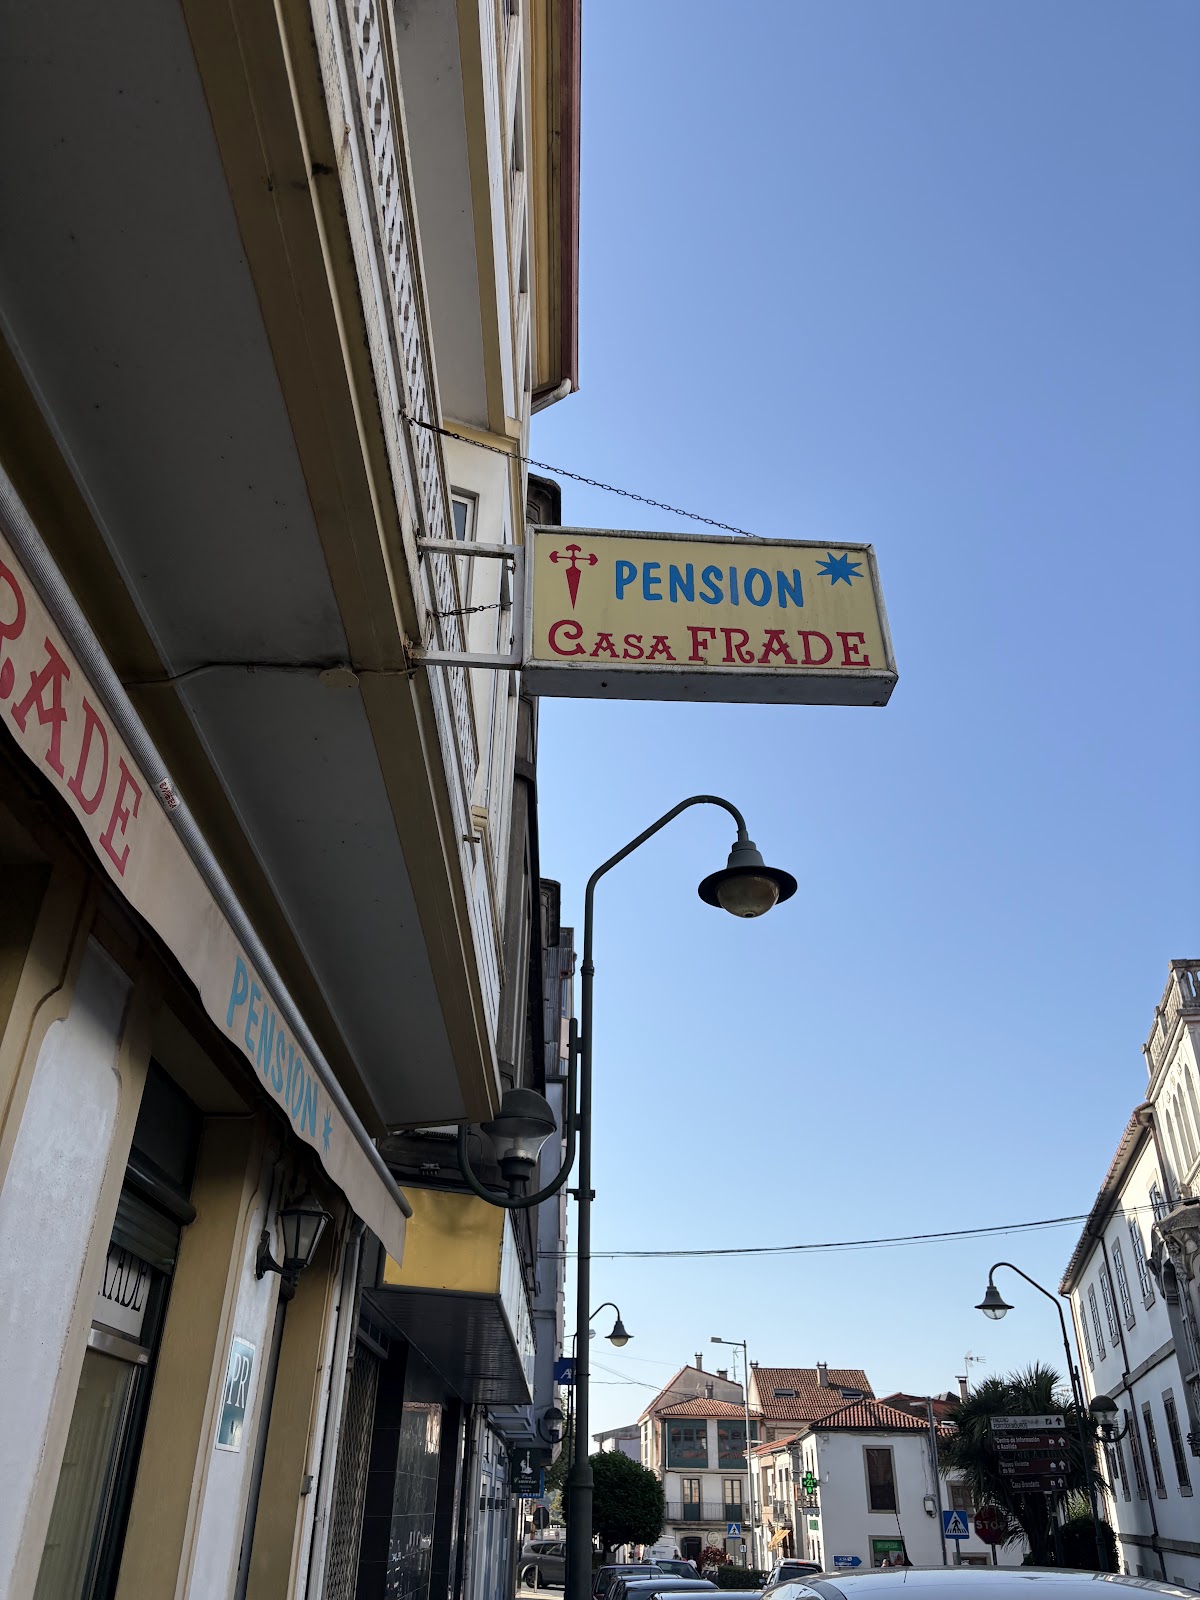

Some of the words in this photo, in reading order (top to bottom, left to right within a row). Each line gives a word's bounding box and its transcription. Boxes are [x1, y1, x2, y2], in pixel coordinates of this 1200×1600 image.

[614, 559, 805, 608] PENSION
[686, 625, 871, 667] FRADE
[226, 955, 319, 1138] PENSION
